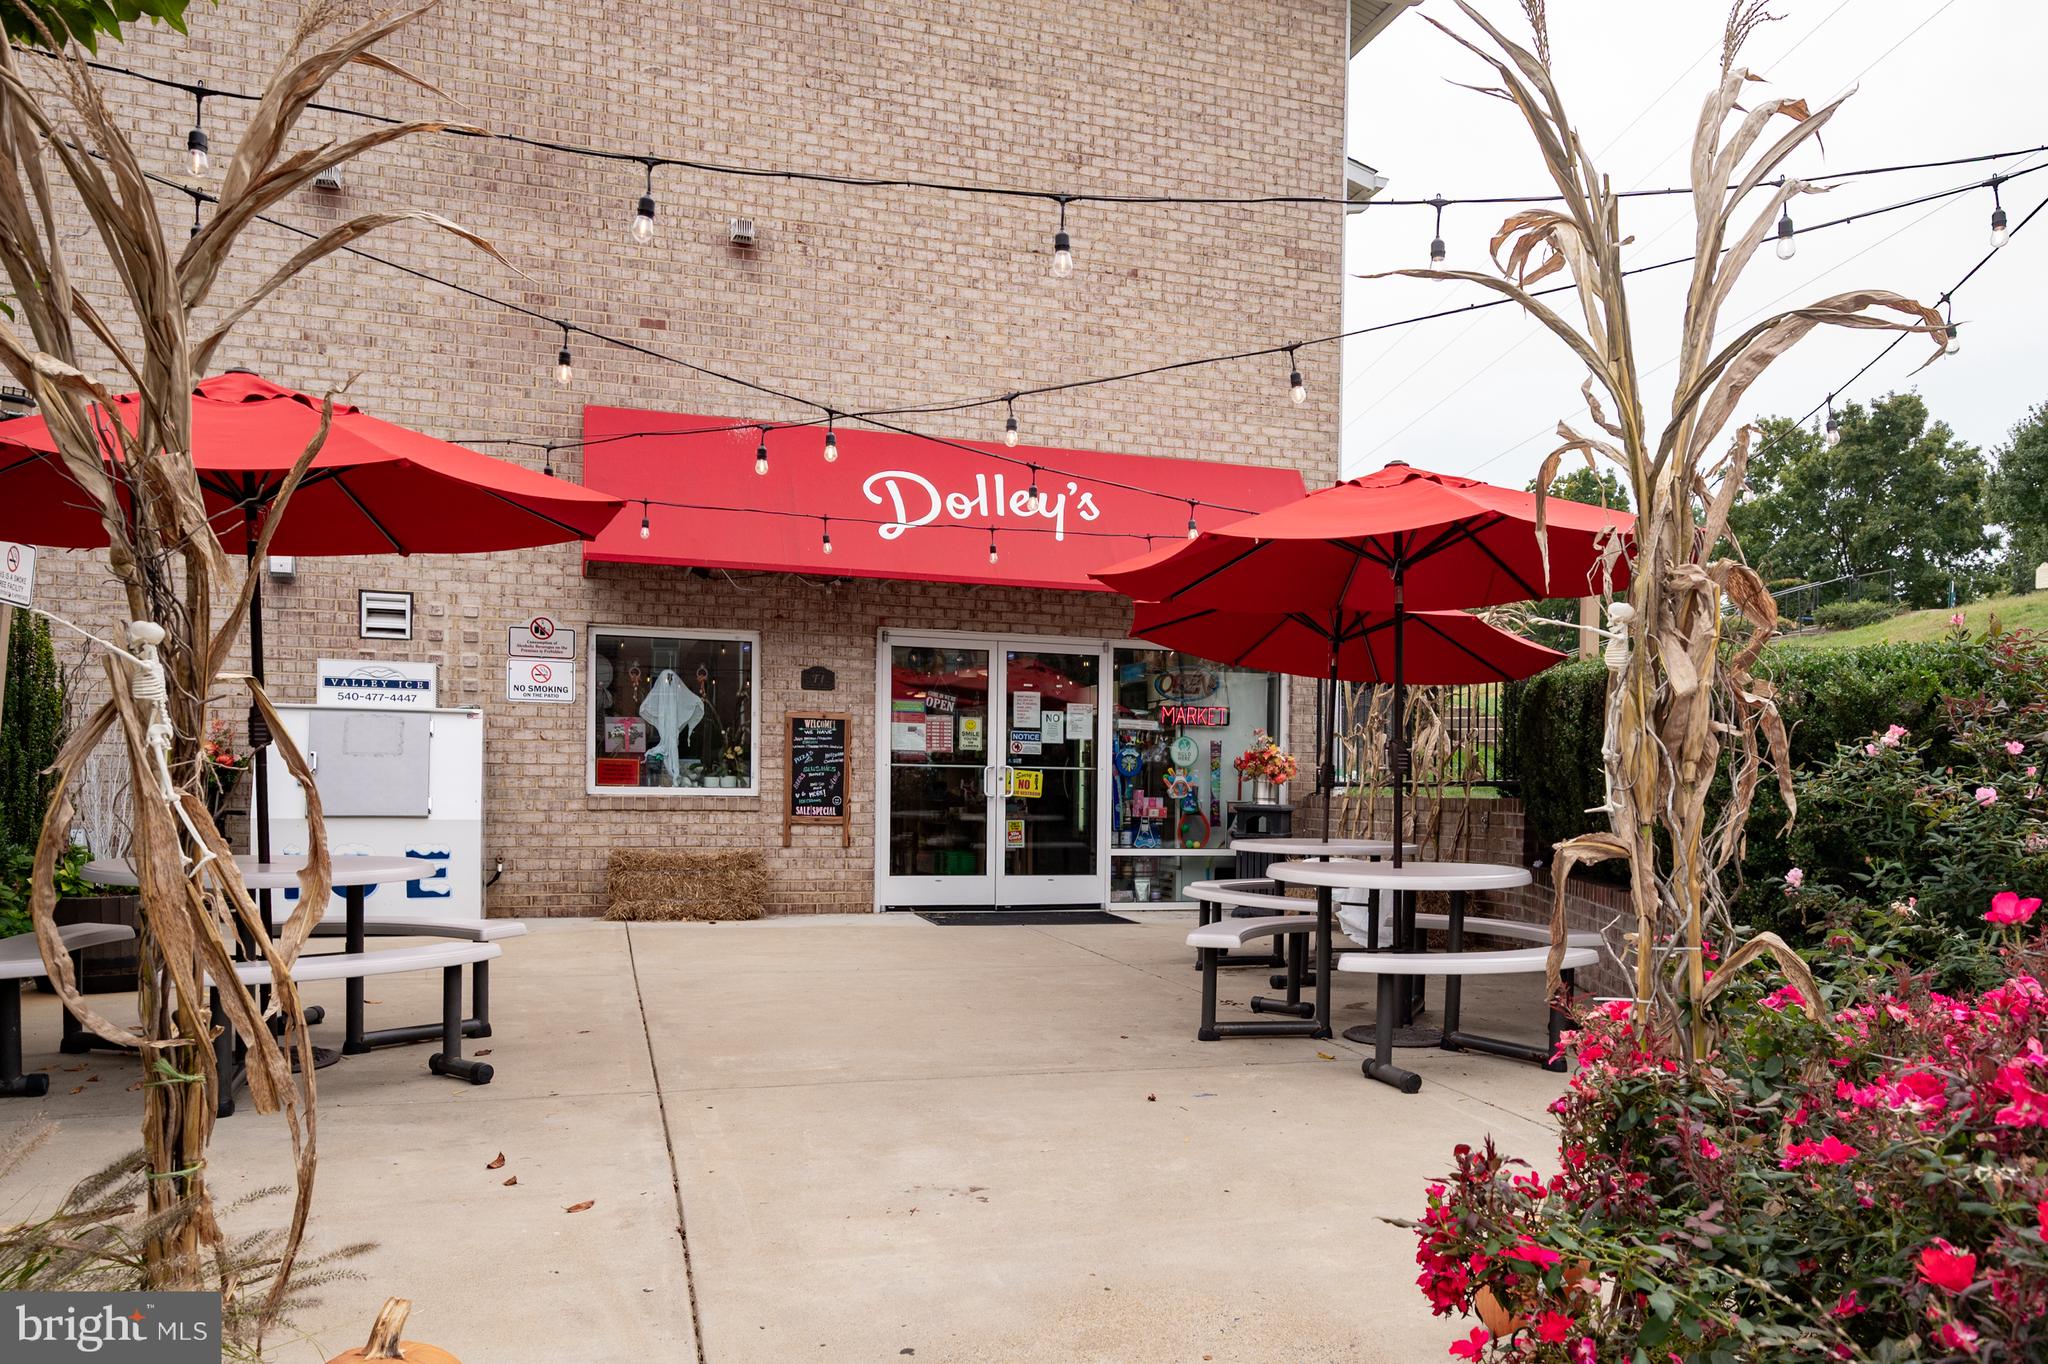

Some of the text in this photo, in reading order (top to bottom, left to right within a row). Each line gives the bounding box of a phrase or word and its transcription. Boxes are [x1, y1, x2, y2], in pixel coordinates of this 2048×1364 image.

[862, 470, 1100, 541] Dolley's
[331, 678, 424, 689] VALLEY ICE
[528, 686, 569, 694] SMOKING
[337, 692, 417, 702] 540-477-4447
[926, 696, 955, 713] OPEN
[1046, 714, 1060, 722] NO
[1161, 706, 1228, 726] MARKET
[1018, 779, 1031, 790] NO
[795, 806, 836, 816] SALE SPECIAL
